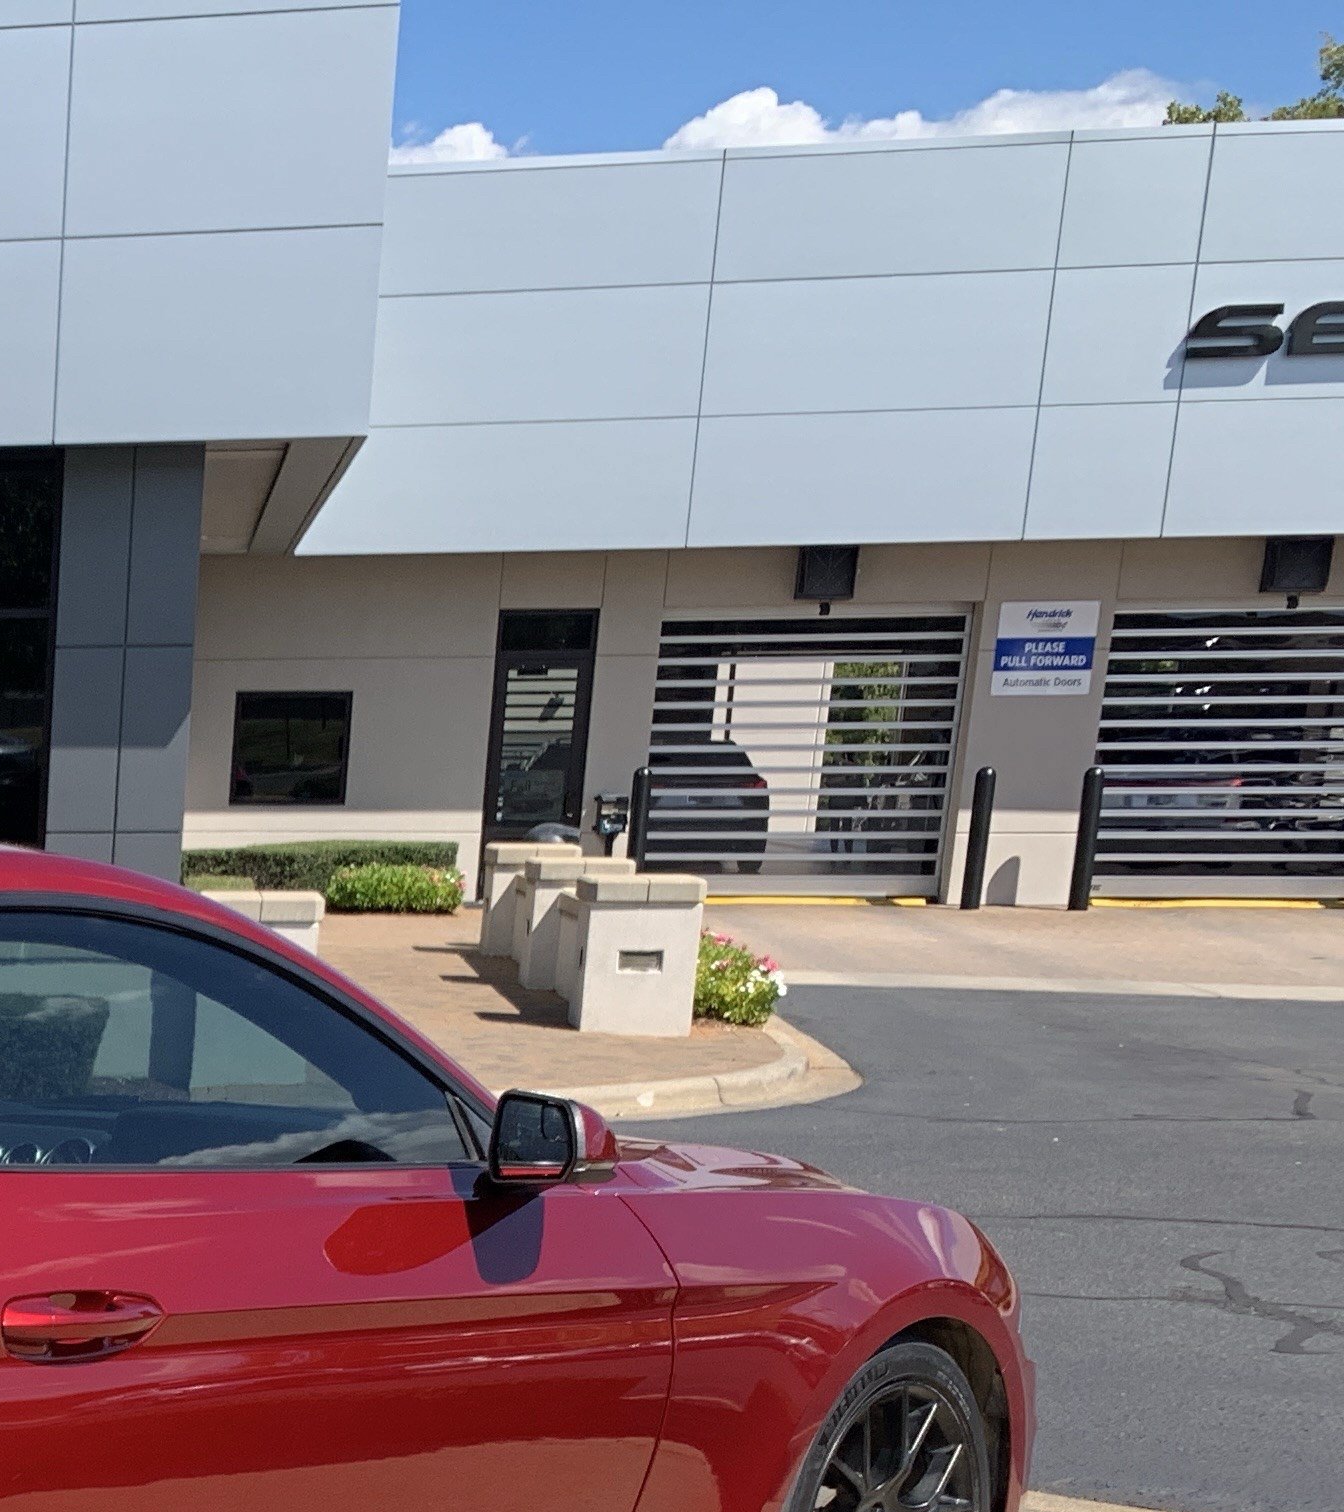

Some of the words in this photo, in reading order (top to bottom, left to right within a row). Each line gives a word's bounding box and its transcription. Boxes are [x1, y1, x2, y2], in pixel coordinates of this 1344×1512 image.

[1024, 642, 1066, 653] PLEASE
[1000, 656, 1028, 667] PULL
[1030, 655, 1087, 667] FORWARD
[1002, 678, 1050, 687] Automatic
[1053, 677, 1082, 687] Doors
